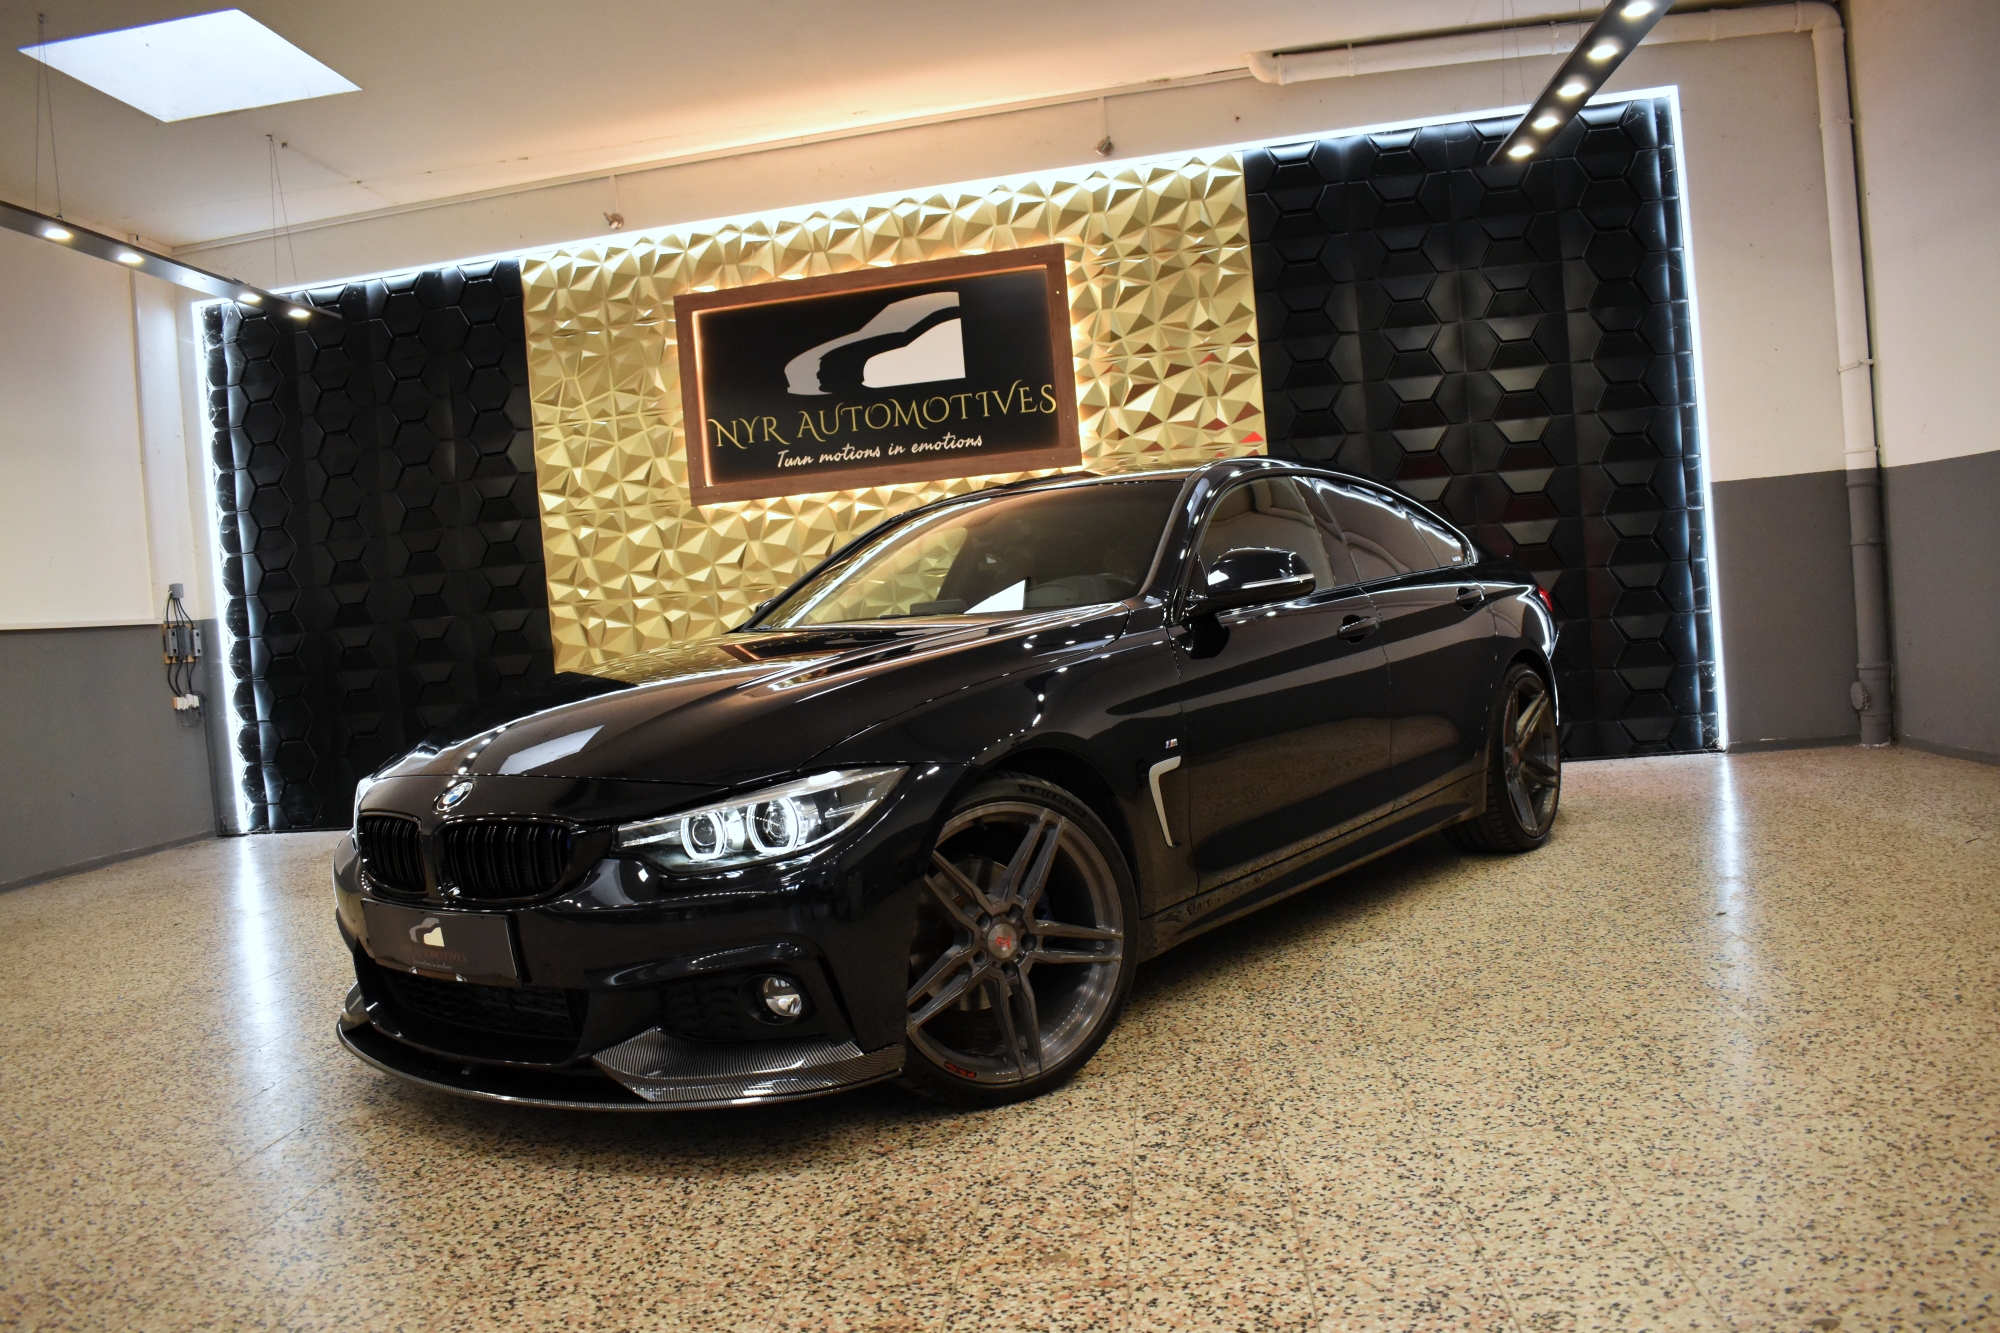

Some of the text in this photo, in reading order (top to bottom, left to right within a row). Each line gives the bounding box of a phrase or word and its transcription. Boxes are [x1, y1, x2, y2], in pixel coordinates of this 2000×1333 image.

[707, 379, 1057, 449] NYR AUTOMOTIVES
[777, 431, 983, 468] Turn motions in emotions
